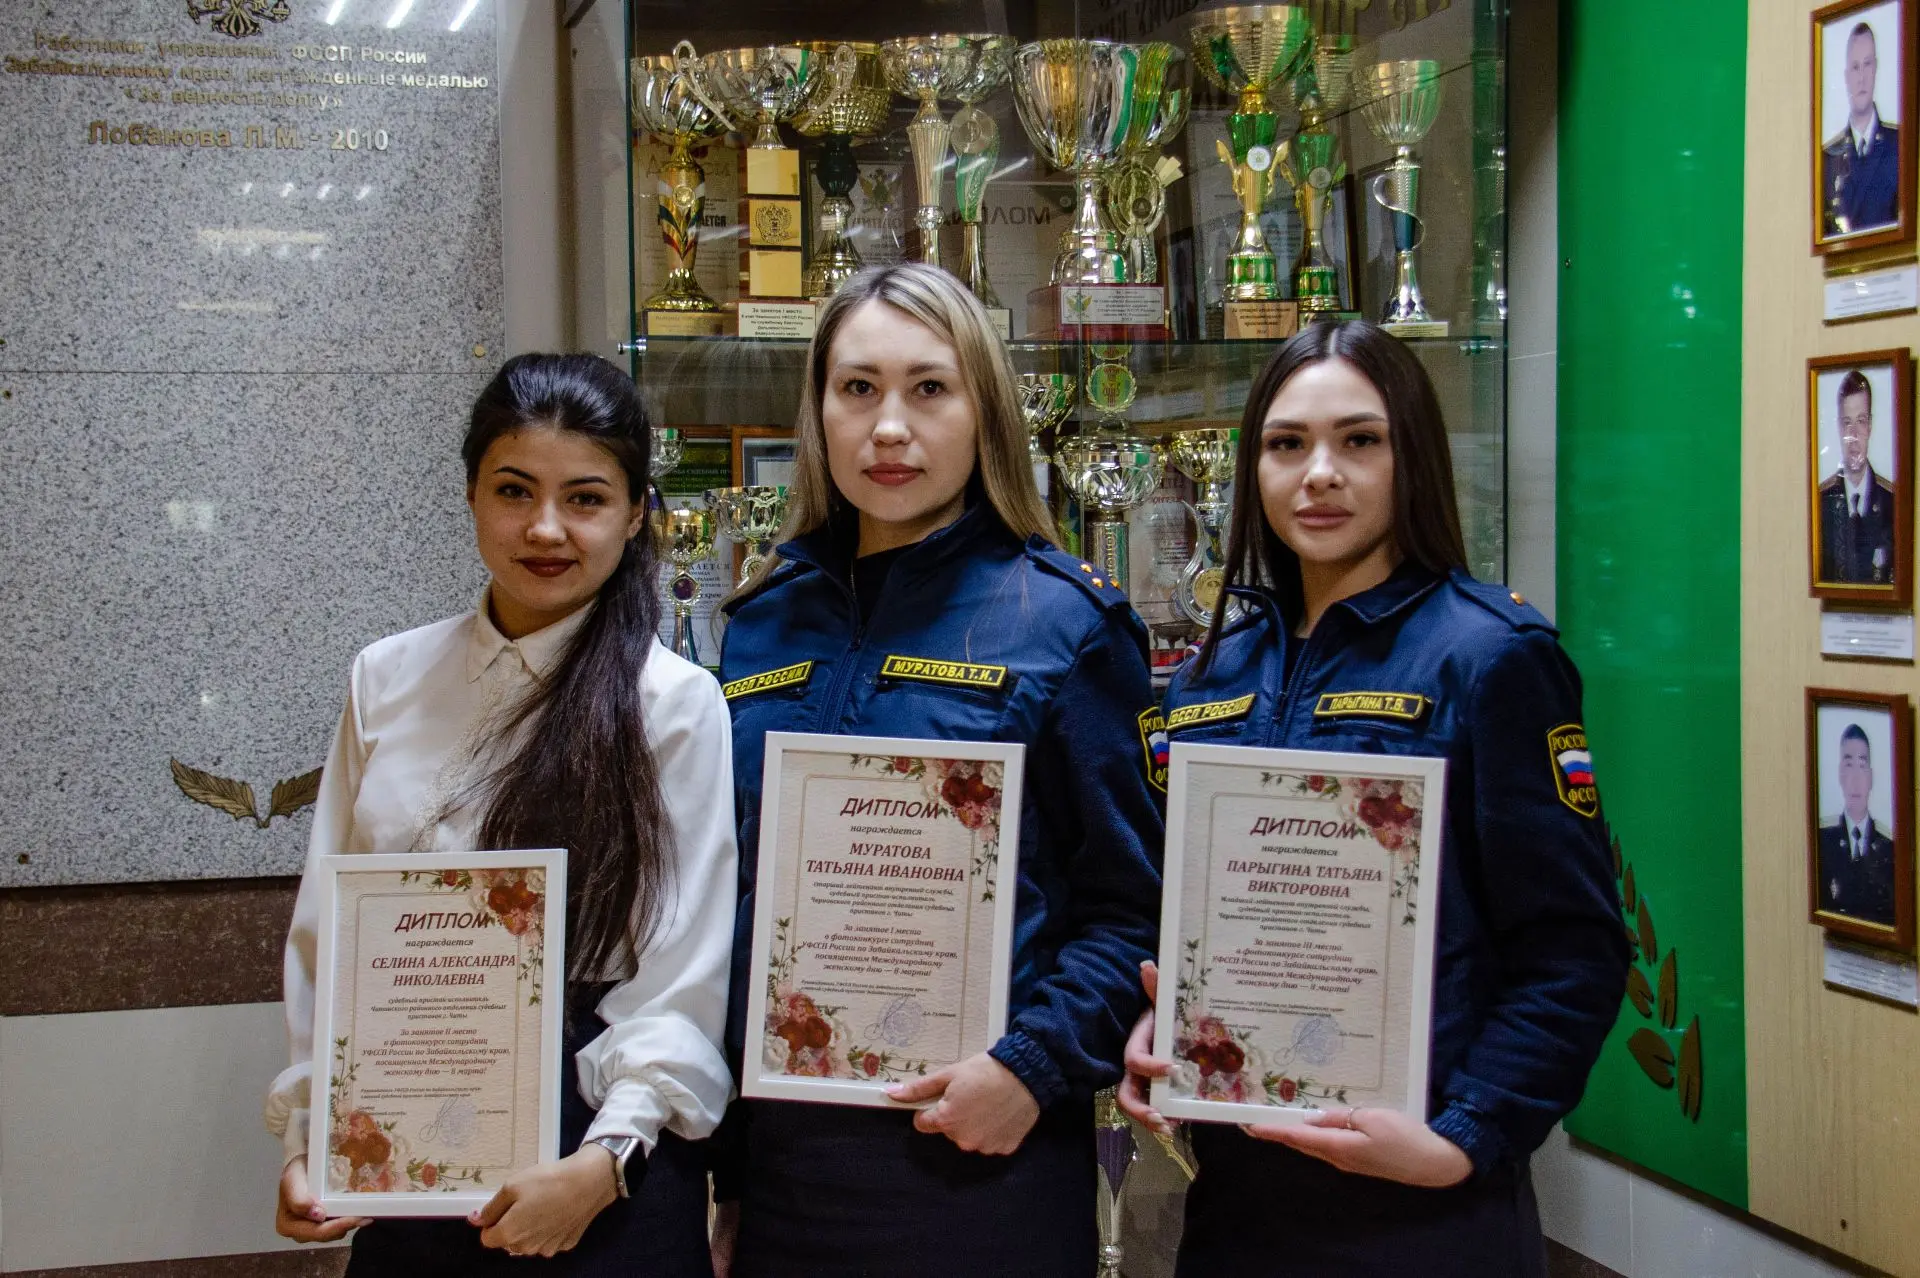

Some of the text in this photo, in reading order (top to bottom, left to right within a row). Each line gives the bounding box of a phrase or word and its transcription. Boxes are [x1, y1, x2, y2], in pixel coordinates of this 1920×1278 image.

[292, 46, 352, 62] ФССП
[361, 48, 427, 64] России
[401, 75, 489, 89] медалью
[88, 119, 232, 147] Лобанова
[331, 128, 389, 150] 2010
[756, 667, 805, 688] РОССИИ
[893, 660, 993, 681] МУРАТОВА Т.И.
[1201, 696, 1253, 718] РОССИИ
[840, 798, 940, 819] ДИПЛОМ
[850, 825, 922, 836] награждается
[1250, 817, 1357, 840] ДИПЛОМ
[850, 843, 931, 860] МУРАТОВА
[1261, 843, 1338, 857] награждается
[806, 860, 964, 882] ТАТЬЯНА ИВАНОВНА
[1226, 859, 1382, 882] ПАРЫГИНА ТАТЬЯНА
[1247, 880, 1350, 898] ВИКТОРОВНА
[394, 912, 489, 933] ДИПЛОМ
[855, 926, 889, 934] занятое
[895, 928, 921, 936] место
[405, 938, 474, 948] награждается
[831, 933, 889, 944] фотоконкурсе
[1254, 938, 1263, 946] За
[800, 941, 827, 950] УФССП
[829, 943, 856, 951] России
[868, 945, 933, 958] Забайкальскому
[372, 955, 516, 969] СЕЛИНА АЛЕКСАНДРА
[823, 964, 865, 973] женскому
[871, 955, 943, 969] Международному
[1241, 958, 1269, 967] России
[393, 973, 485, 986] НИКОЛАЕВНА
[1286, 971, 1362, 984] Международному
[390, 1039, 446, 1047] фотоконкурсе
[426, 1048, 488, 1056] Забайкальскому
[429, 1058, 496, 1066] Международному
